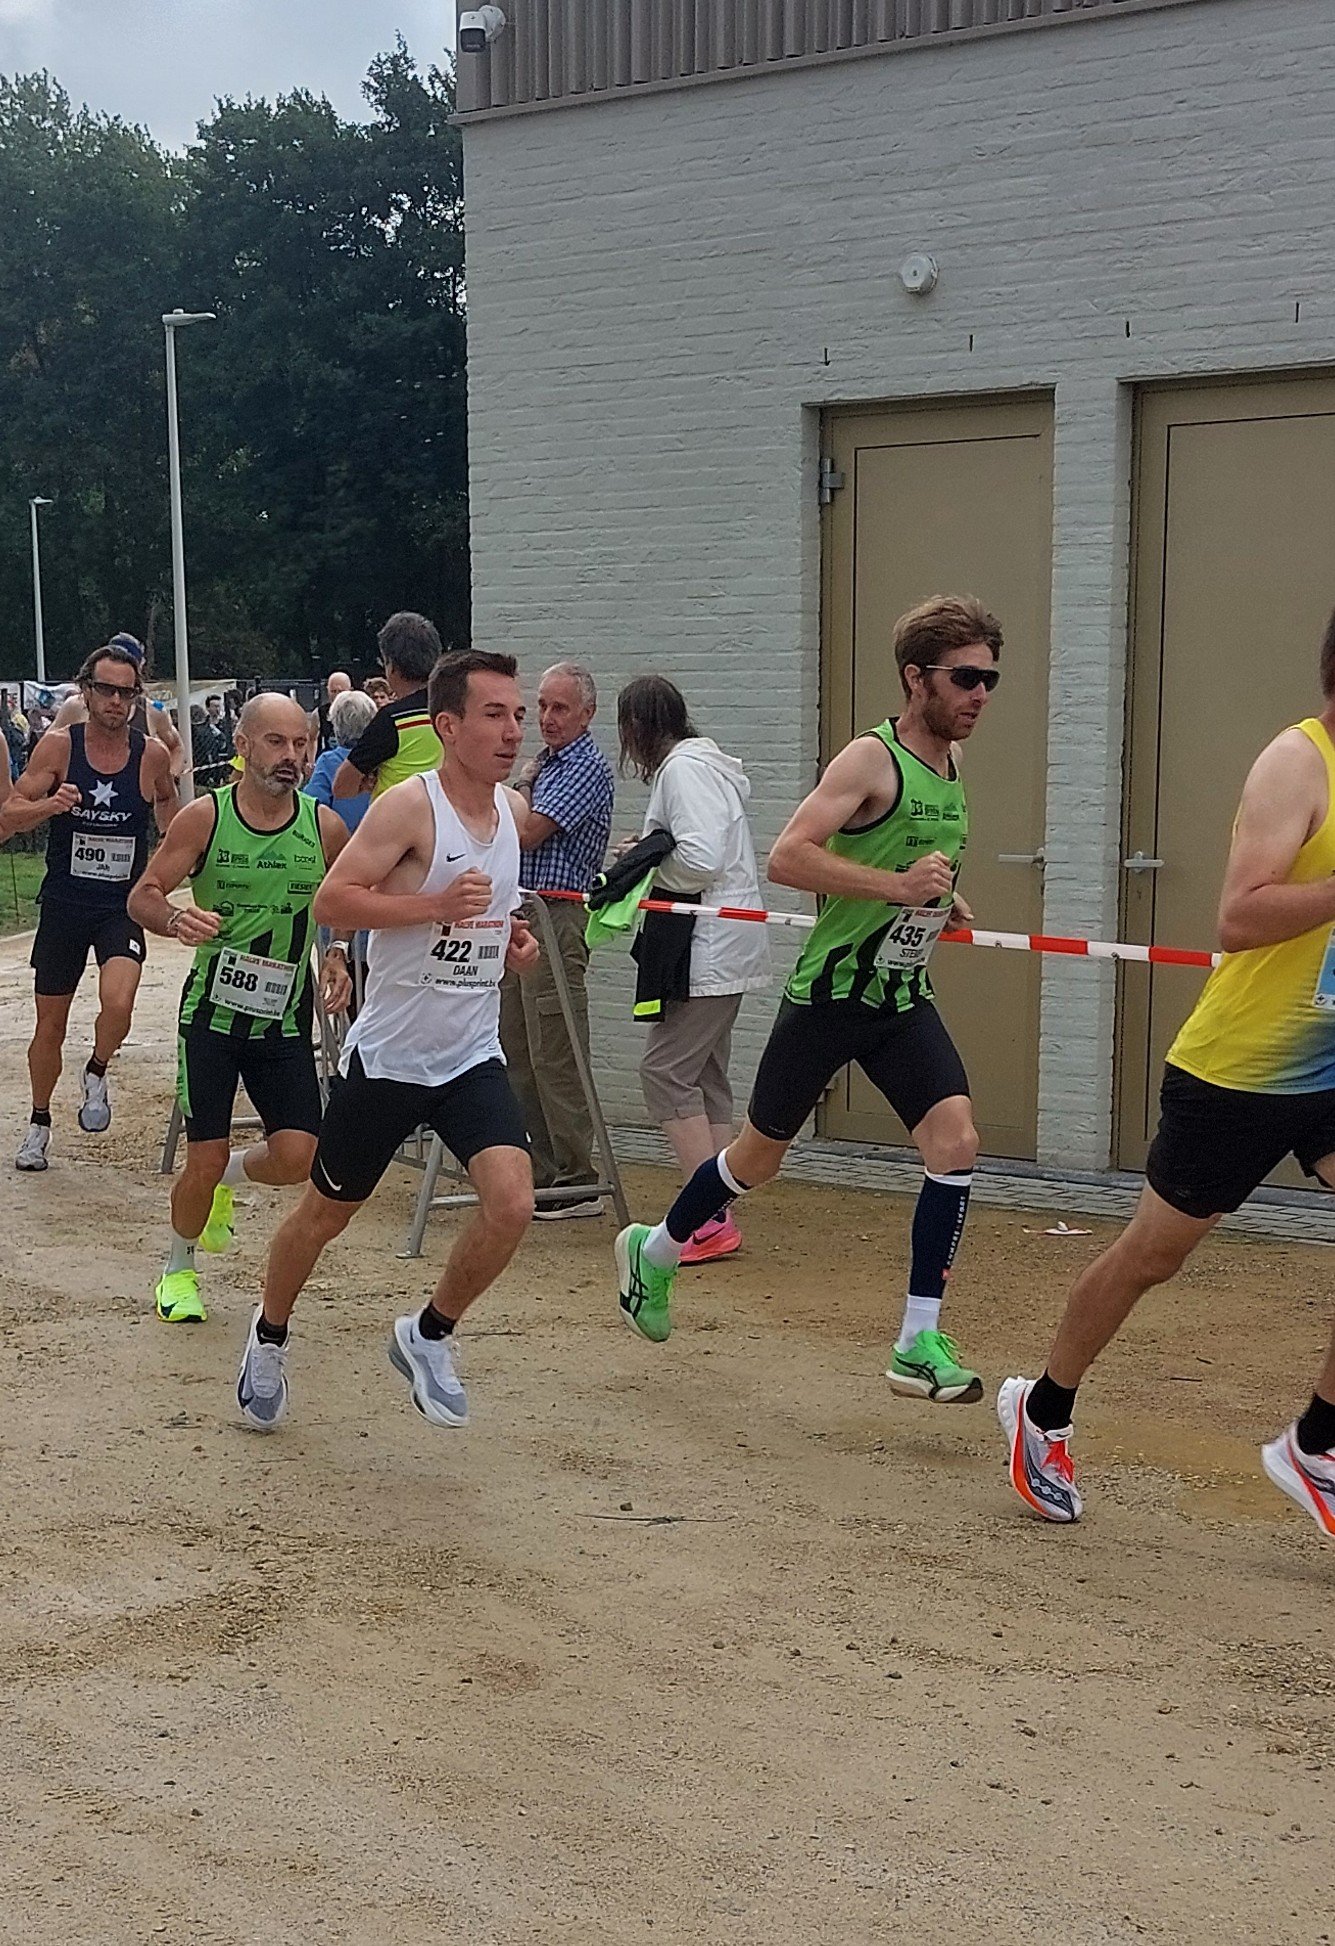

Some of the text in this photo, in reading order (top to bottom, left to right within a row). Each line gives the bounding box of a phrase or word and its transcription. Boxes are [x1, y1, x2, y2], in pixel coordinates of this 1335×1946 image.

[71, 806, 133, 822] SAYSKY
[75, 847, 106, 863] 490
[889, 924, 927, 947] 435
[430, 939, 472, 962] 422
[219, 966, 259, 992] 588
[452, 965, 479, 976] DAAN
